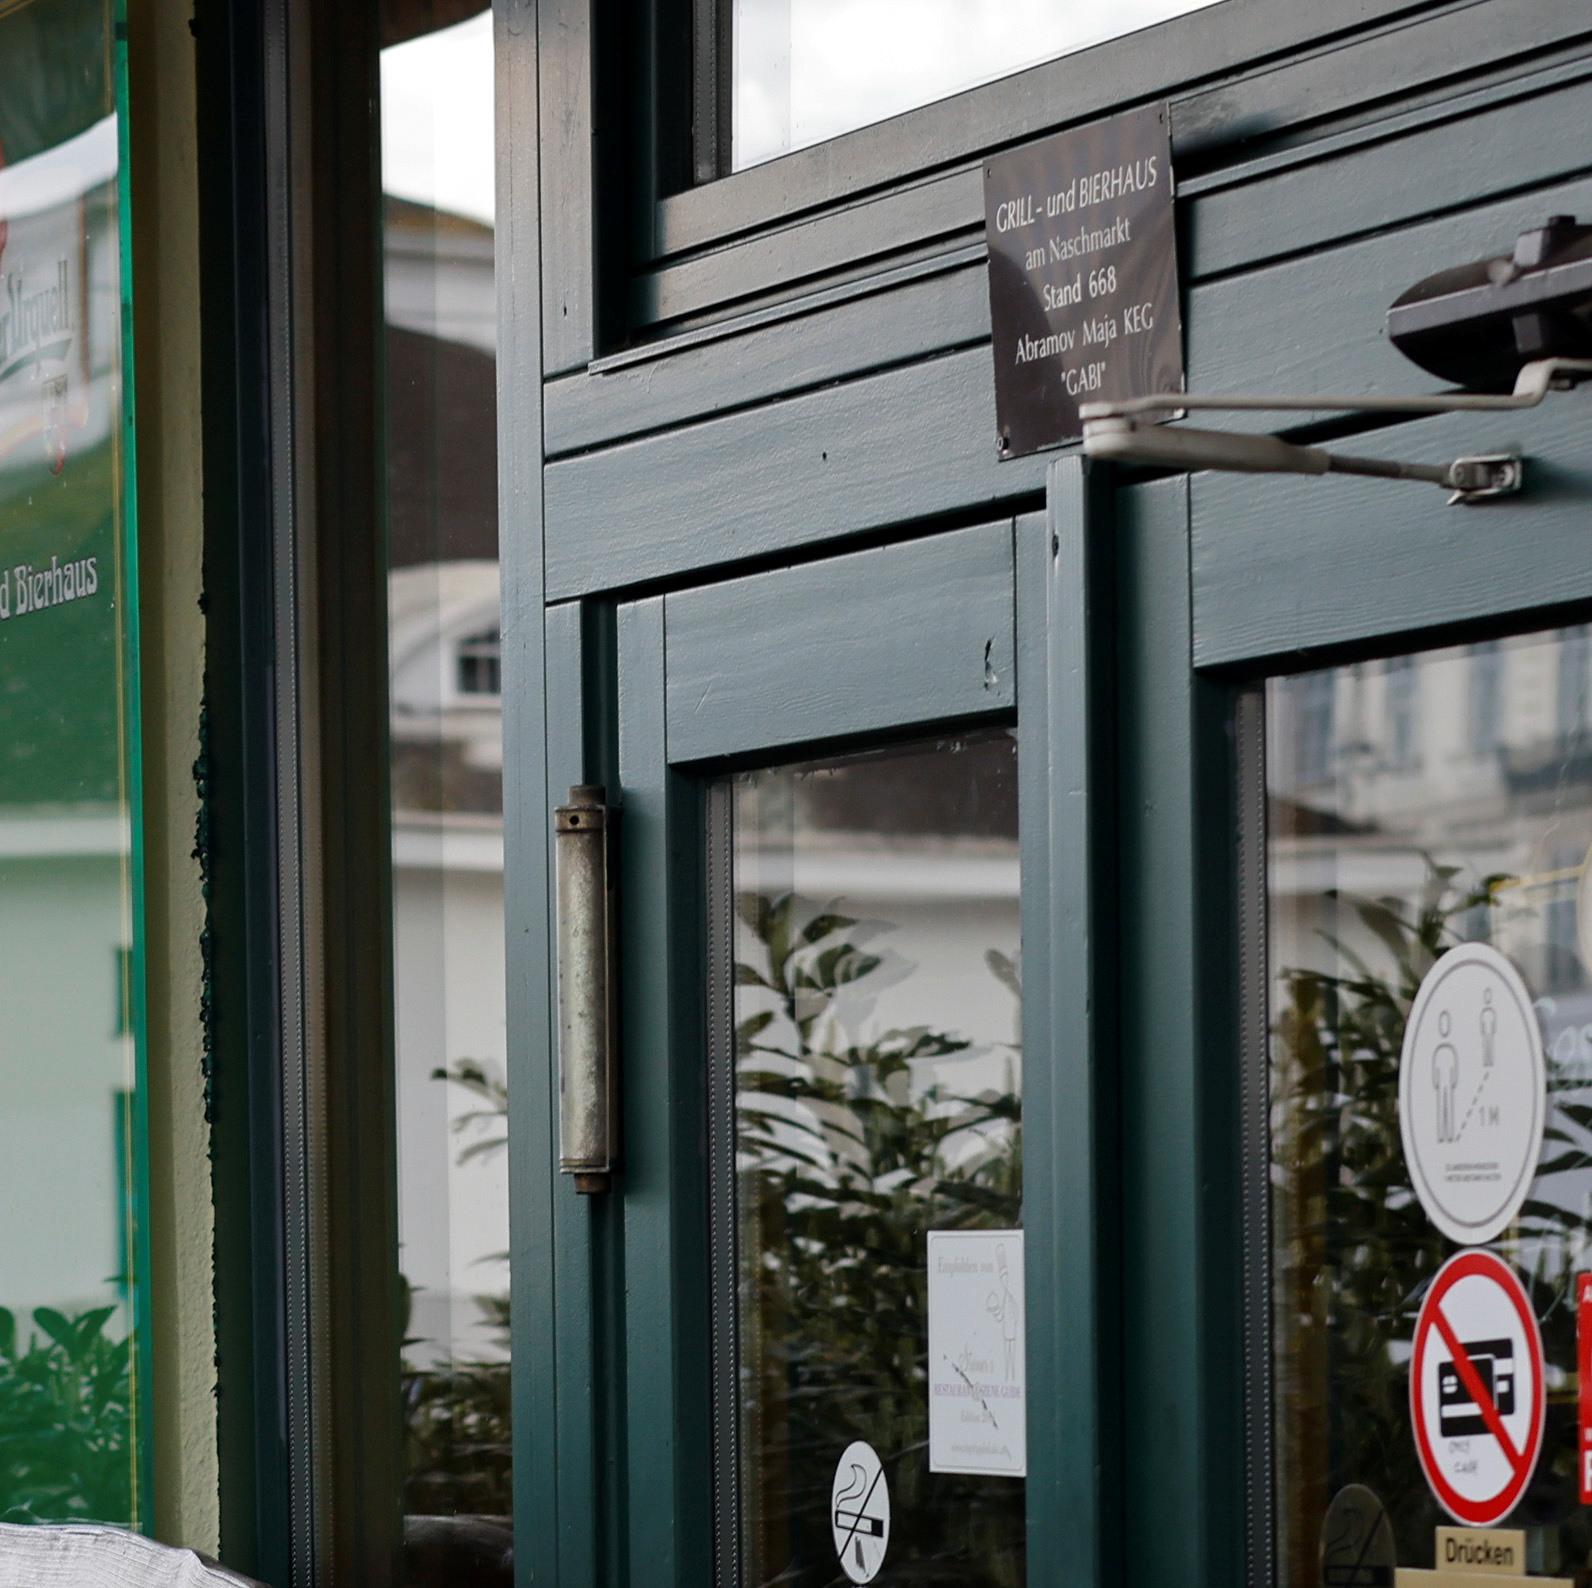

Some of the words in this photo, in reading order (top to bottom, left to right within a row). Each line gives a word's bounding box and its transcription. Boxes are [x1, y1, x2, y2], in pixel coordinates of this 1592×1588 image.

[1047, 178, 1076, 218] und
[1079, 155, 1158, 209] BIERHAUS
[1025, 246, 1046, 271] am
[1049, 216, 1132, 265] Naschmarkt
[1043, 272, 1082, 312] Stand
[1088, 265, 1117, 299] 668
[1014, 327, 1075, 365] Abramov
[1082, 313, 1117, 349] Maja
[1123, 302, 1154, 336] KEG
[14, 555, 98, 616] Bierhaus
[1445, 1536, 1515, 1567] Drücken
